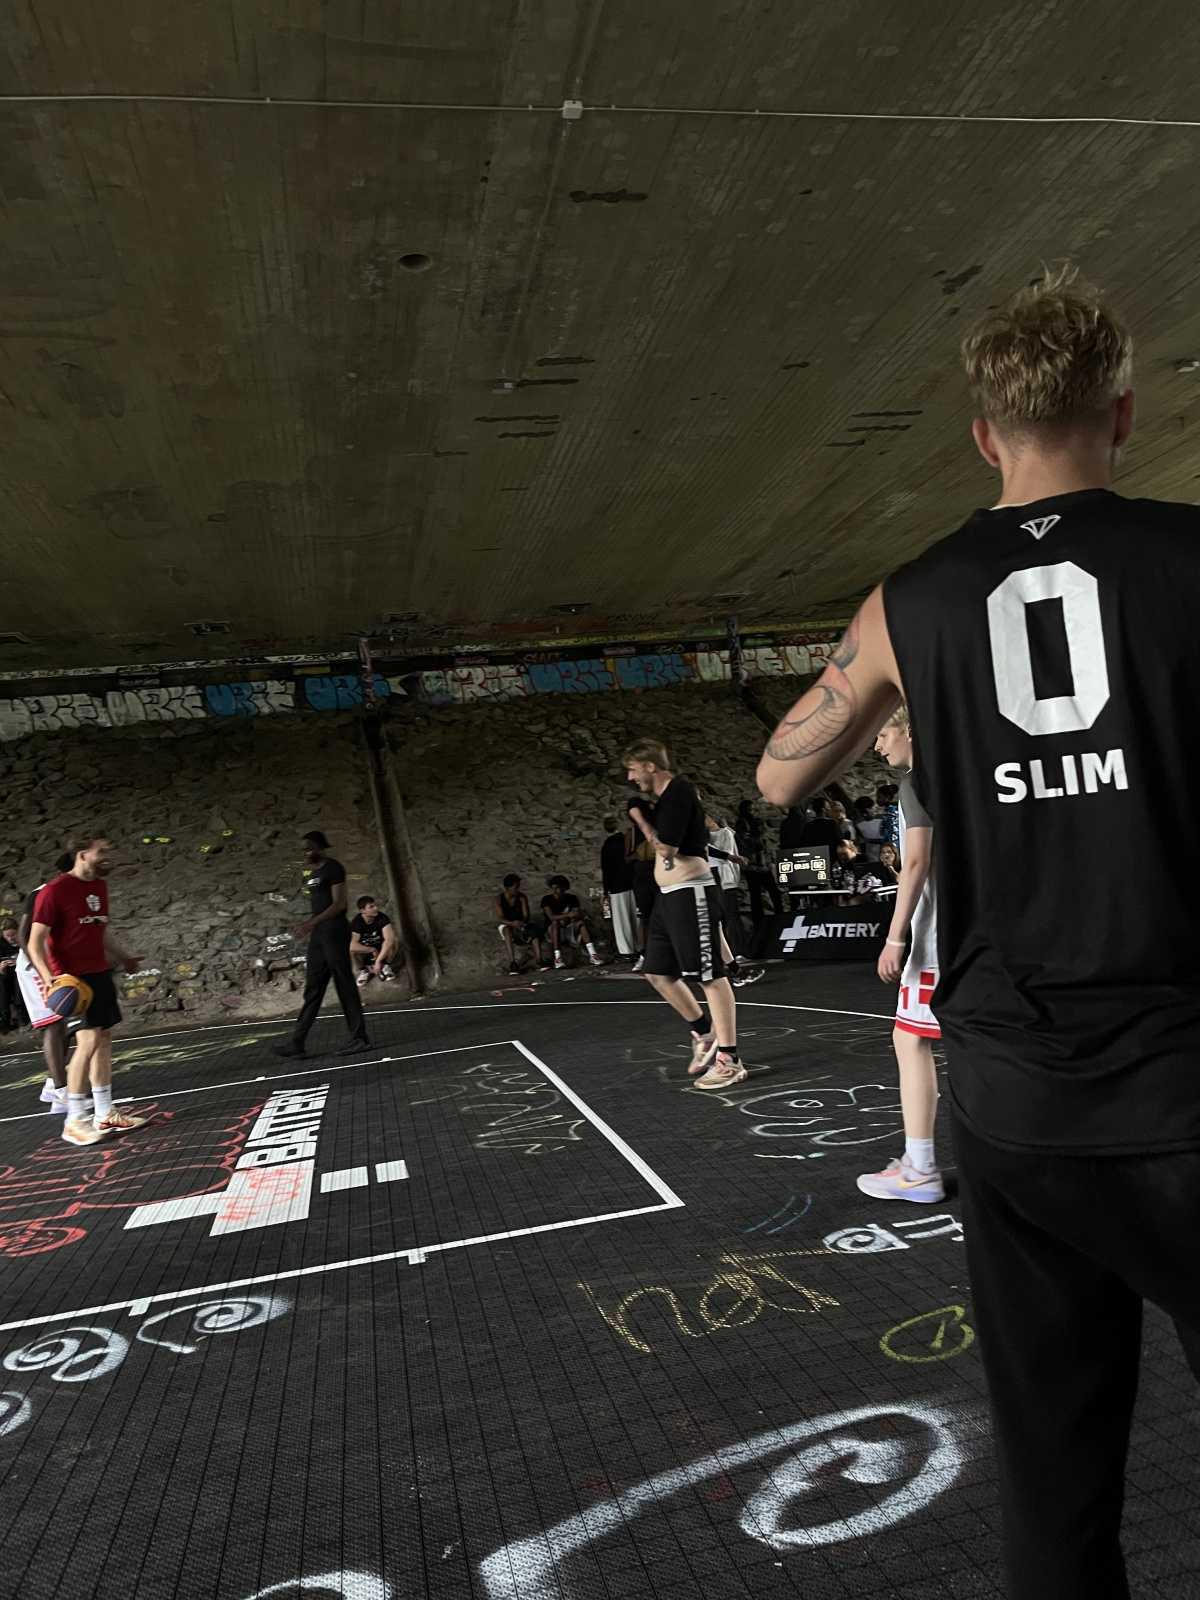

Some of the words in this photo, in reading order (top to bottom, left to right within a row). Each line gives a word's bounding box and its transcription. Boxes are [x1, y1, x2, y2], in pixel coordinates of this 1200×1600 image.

[986, 560, 1110, 736] 0
[994, 748, 1129, 804] SLIM
[807, 922, 880, 939] BATTERY
[235, 1083, 330, 1170] BATTERY
